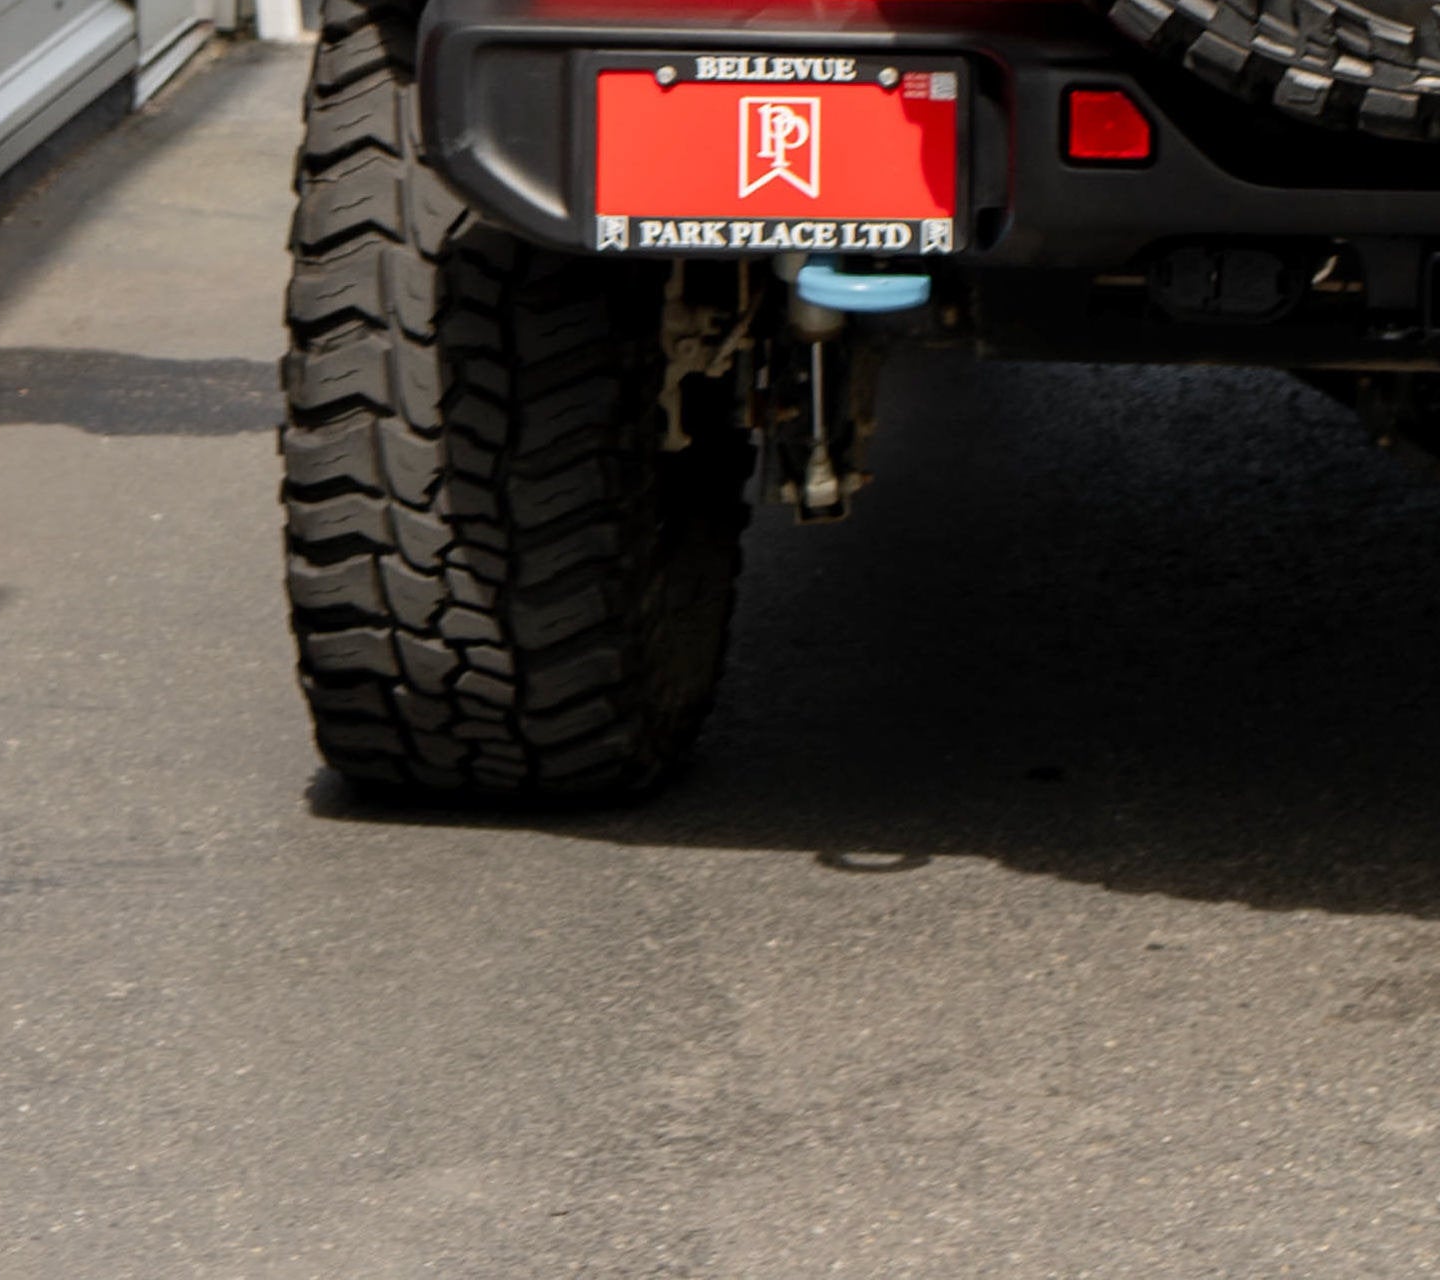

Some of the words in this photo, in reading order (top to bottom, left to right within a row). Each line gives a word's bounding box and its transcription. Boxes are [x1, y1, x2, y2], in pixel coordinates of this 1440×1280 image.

[696, 56, 858, 82] BELLEVUE
[639, 220, 728, 248] PARK
[728, 222, 838, 249] PLACE
[840, 223, 912, 249] LTD
